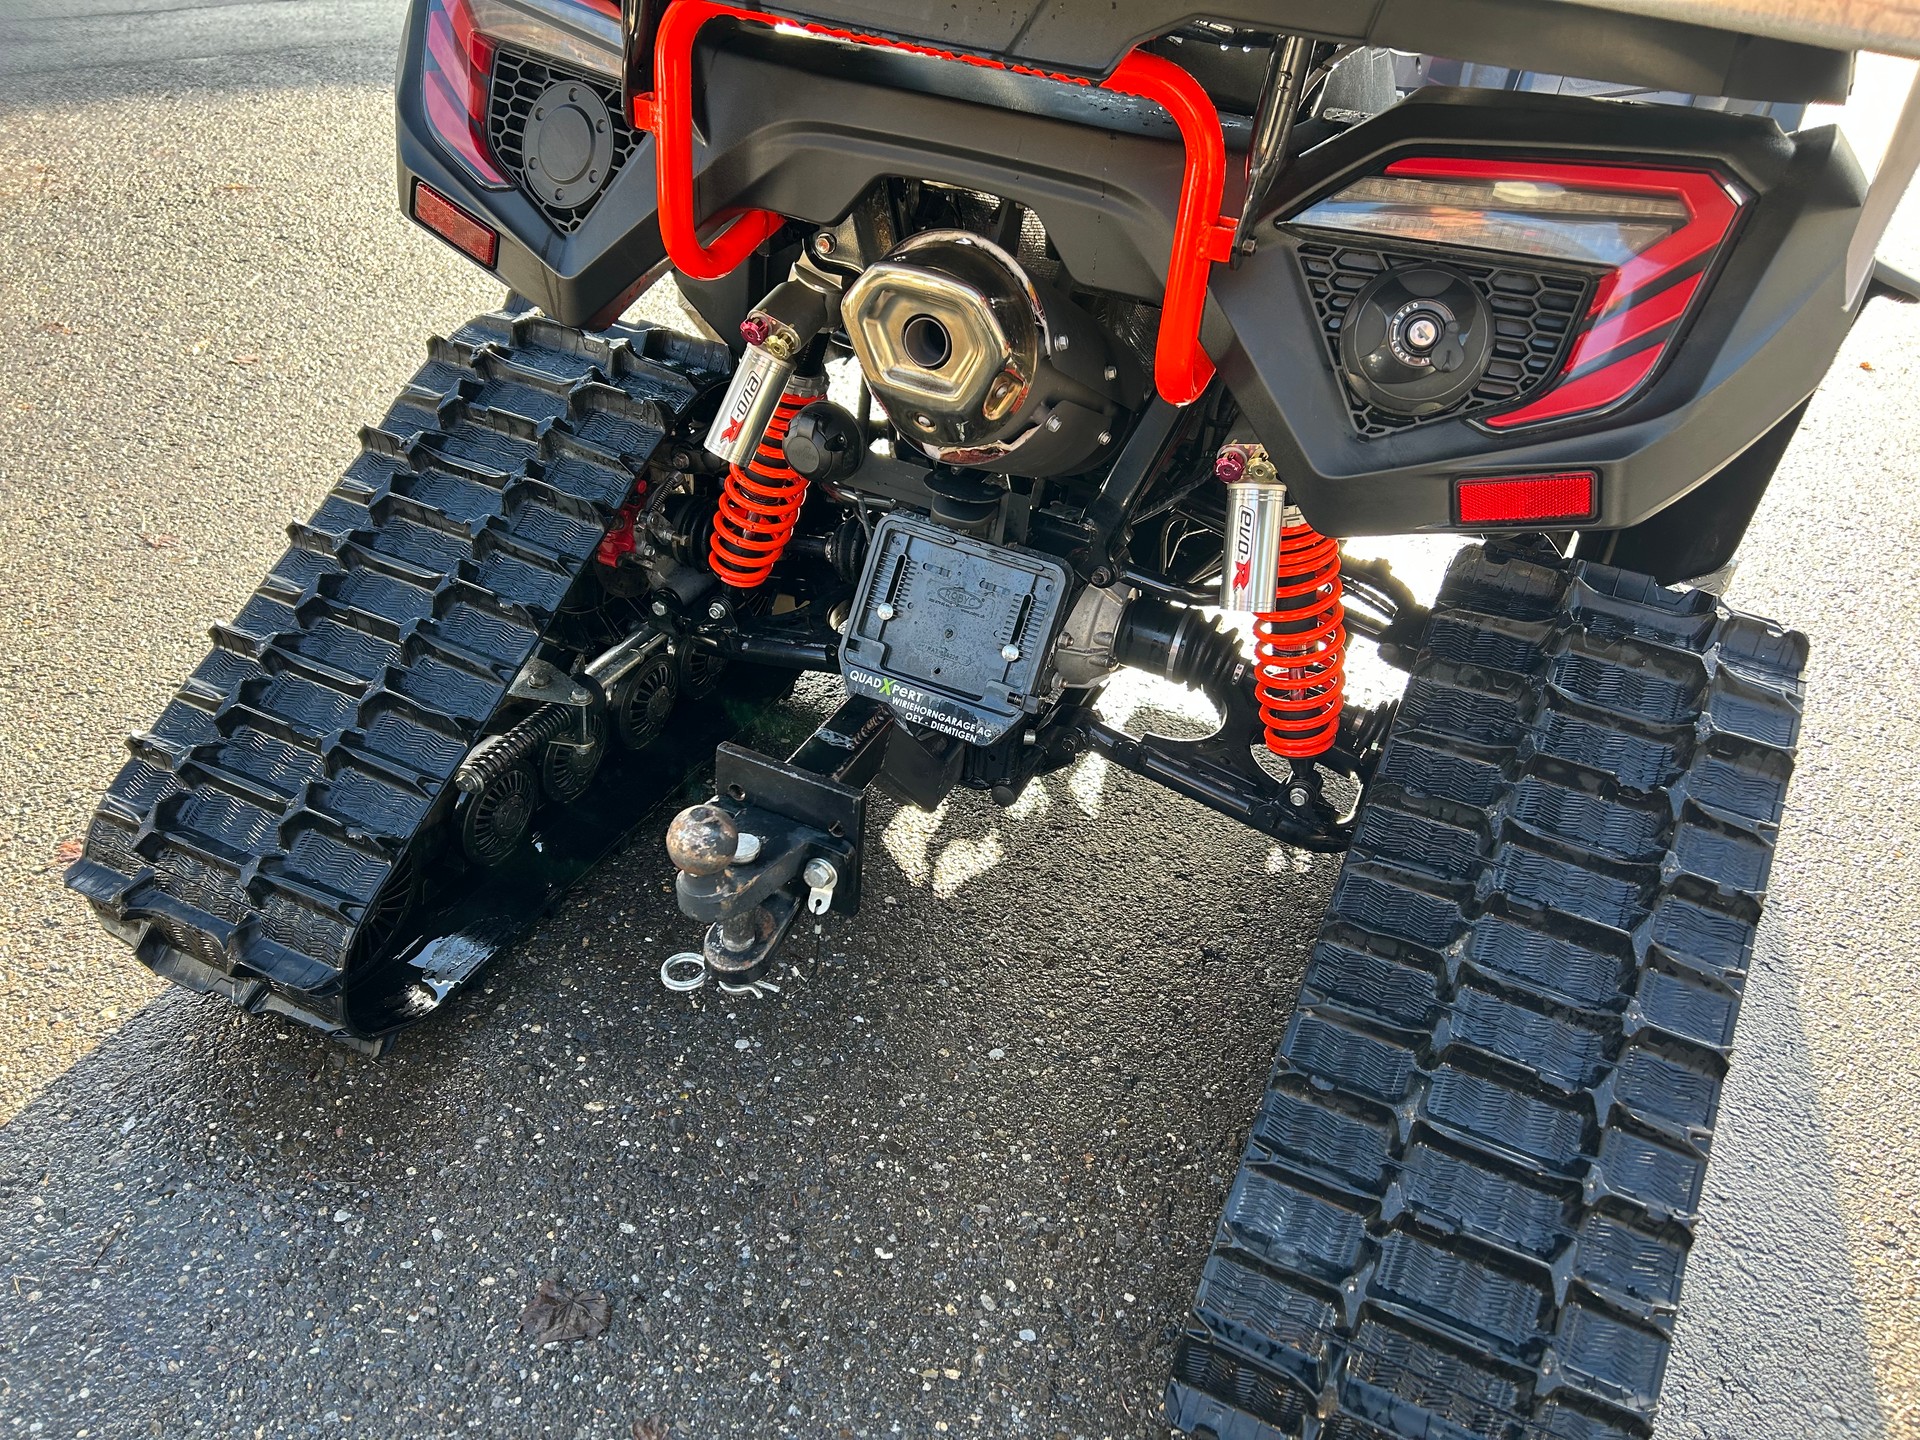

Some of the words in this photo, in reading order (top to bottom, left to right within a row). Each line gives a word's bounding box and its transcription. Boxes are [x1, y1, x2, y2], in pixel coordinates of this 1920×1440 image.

[1393, 302, 1418, 324] OPEN
[1391, 341, 1411, 362] LOCK
[892, 696, 977, 732] WIRIEHORNGARAGE
[976, 728, 992, 738] AG
[905, 712, 923, 724] OEY
[930, 720, 978, 743] DIEMTIGEN
